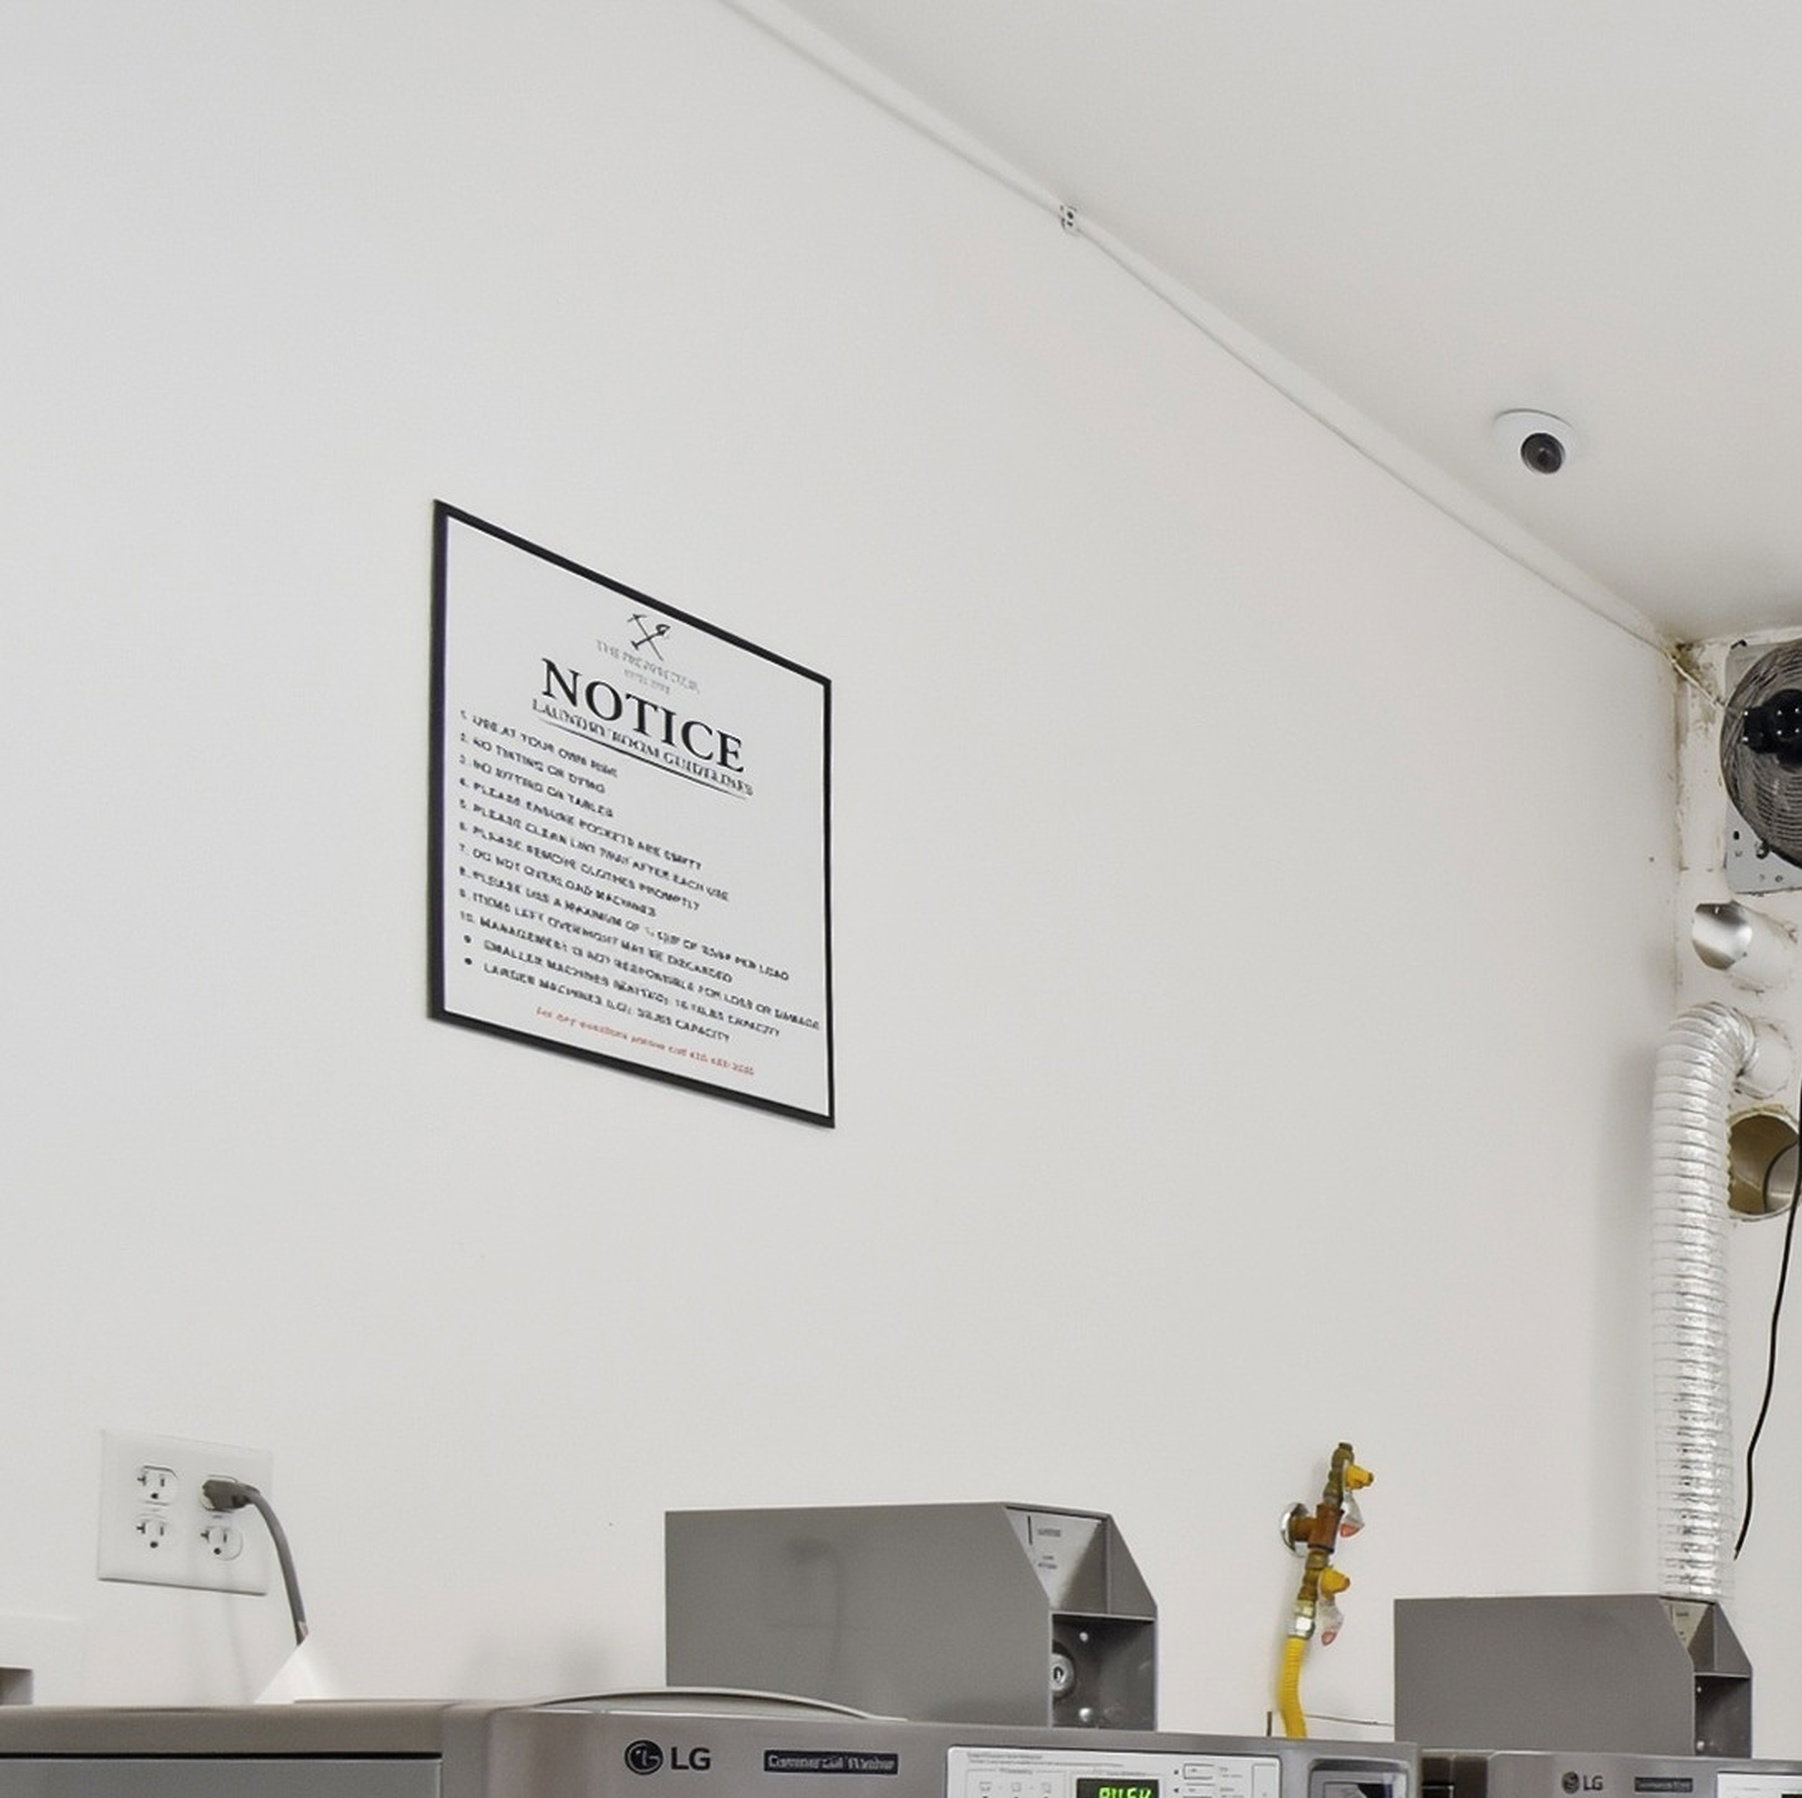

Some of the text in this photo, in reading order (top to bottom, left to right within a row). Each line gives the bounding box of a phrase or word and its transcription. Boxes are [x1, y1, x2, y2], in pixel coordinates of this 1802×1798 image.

[532, 696, 754, 797] LAUNDRY ROOM GUIDELINES
[541, 655, 744, 777] NOTICE
[671, 1747, 711, 1771] LG
[1583, 1775, 1603, 1791] LG
